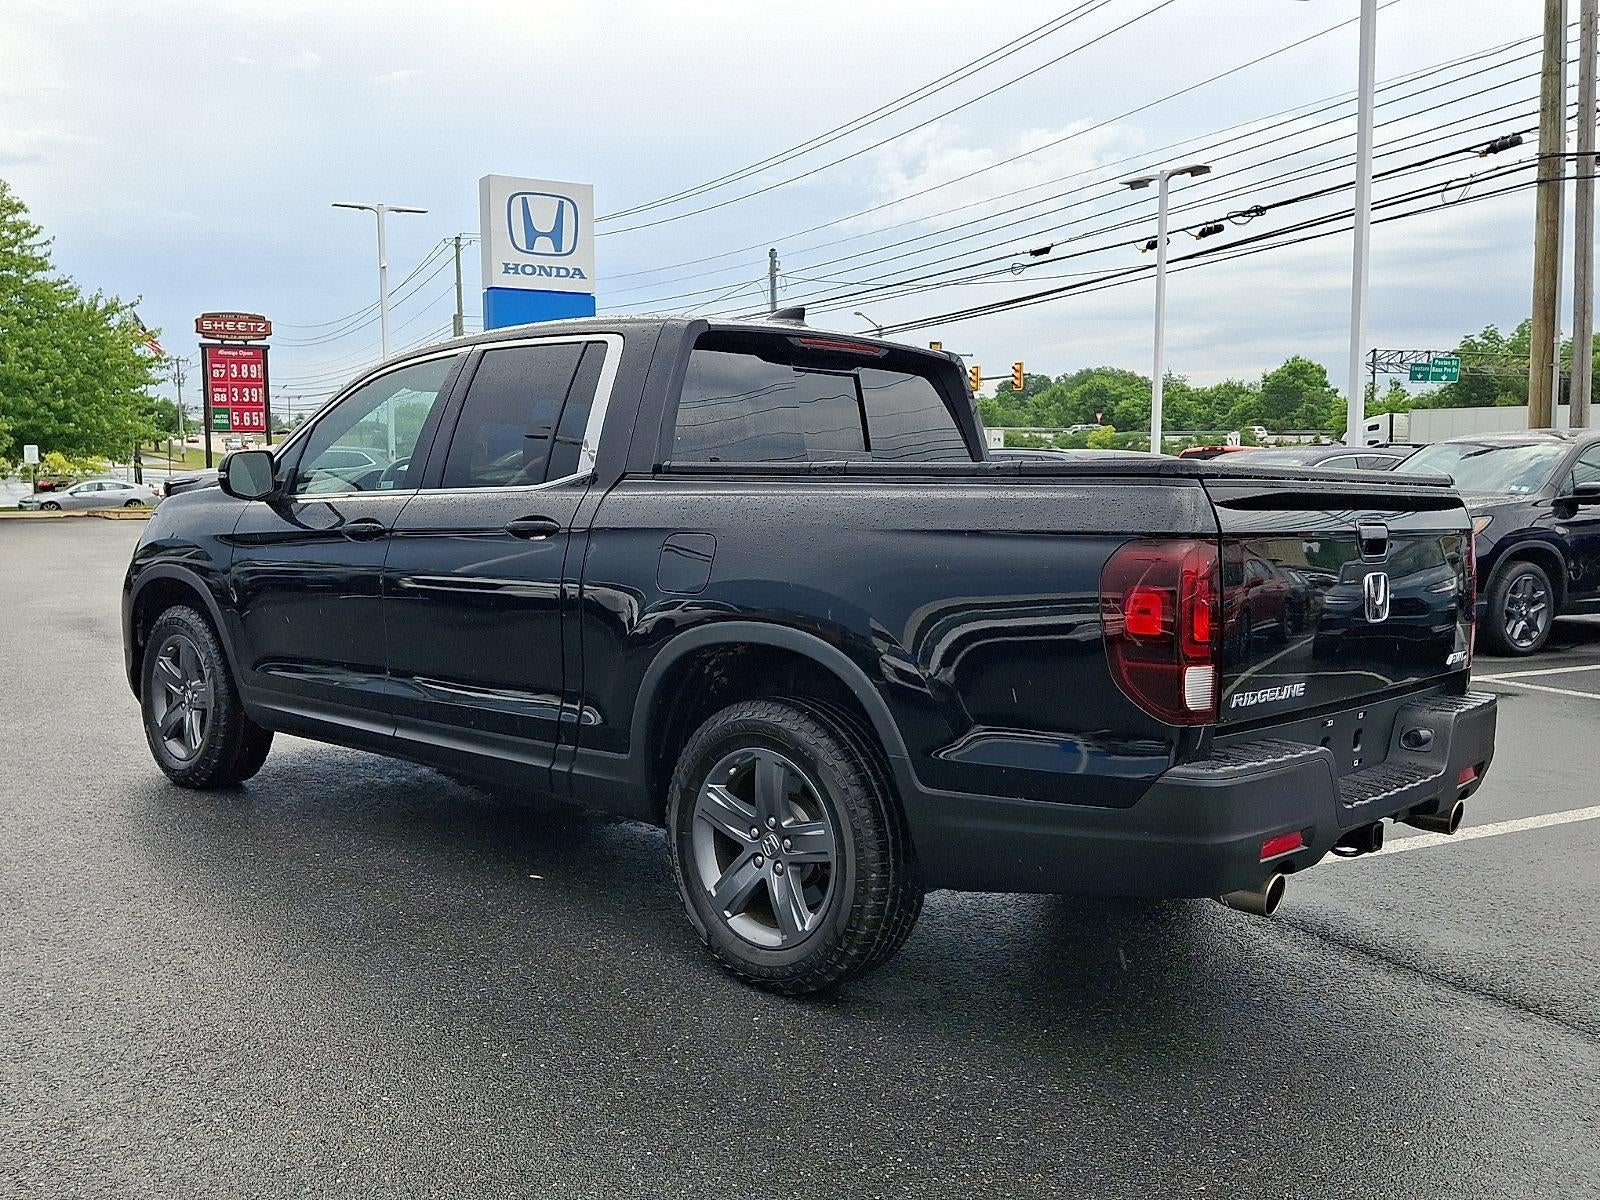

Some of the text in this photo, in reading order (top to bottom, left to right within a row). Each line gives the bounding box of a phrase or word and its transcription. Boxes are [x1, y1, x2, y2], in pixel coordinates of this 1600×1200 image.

[501, 262, 587, 280] HONDA
[202, 320, 266, 332] SHEETZ
[218, 349, 239, 357] Always
[212, 369, 226, 378] 87
[230, 363, 257, 379] 3.89
[213, 393, 227, 402] 88
[231, 387, 258, 403] 3.39
[232, 411, 259, 426] 5.65
[1229, 682, 1306, 709] RIDGELINE
